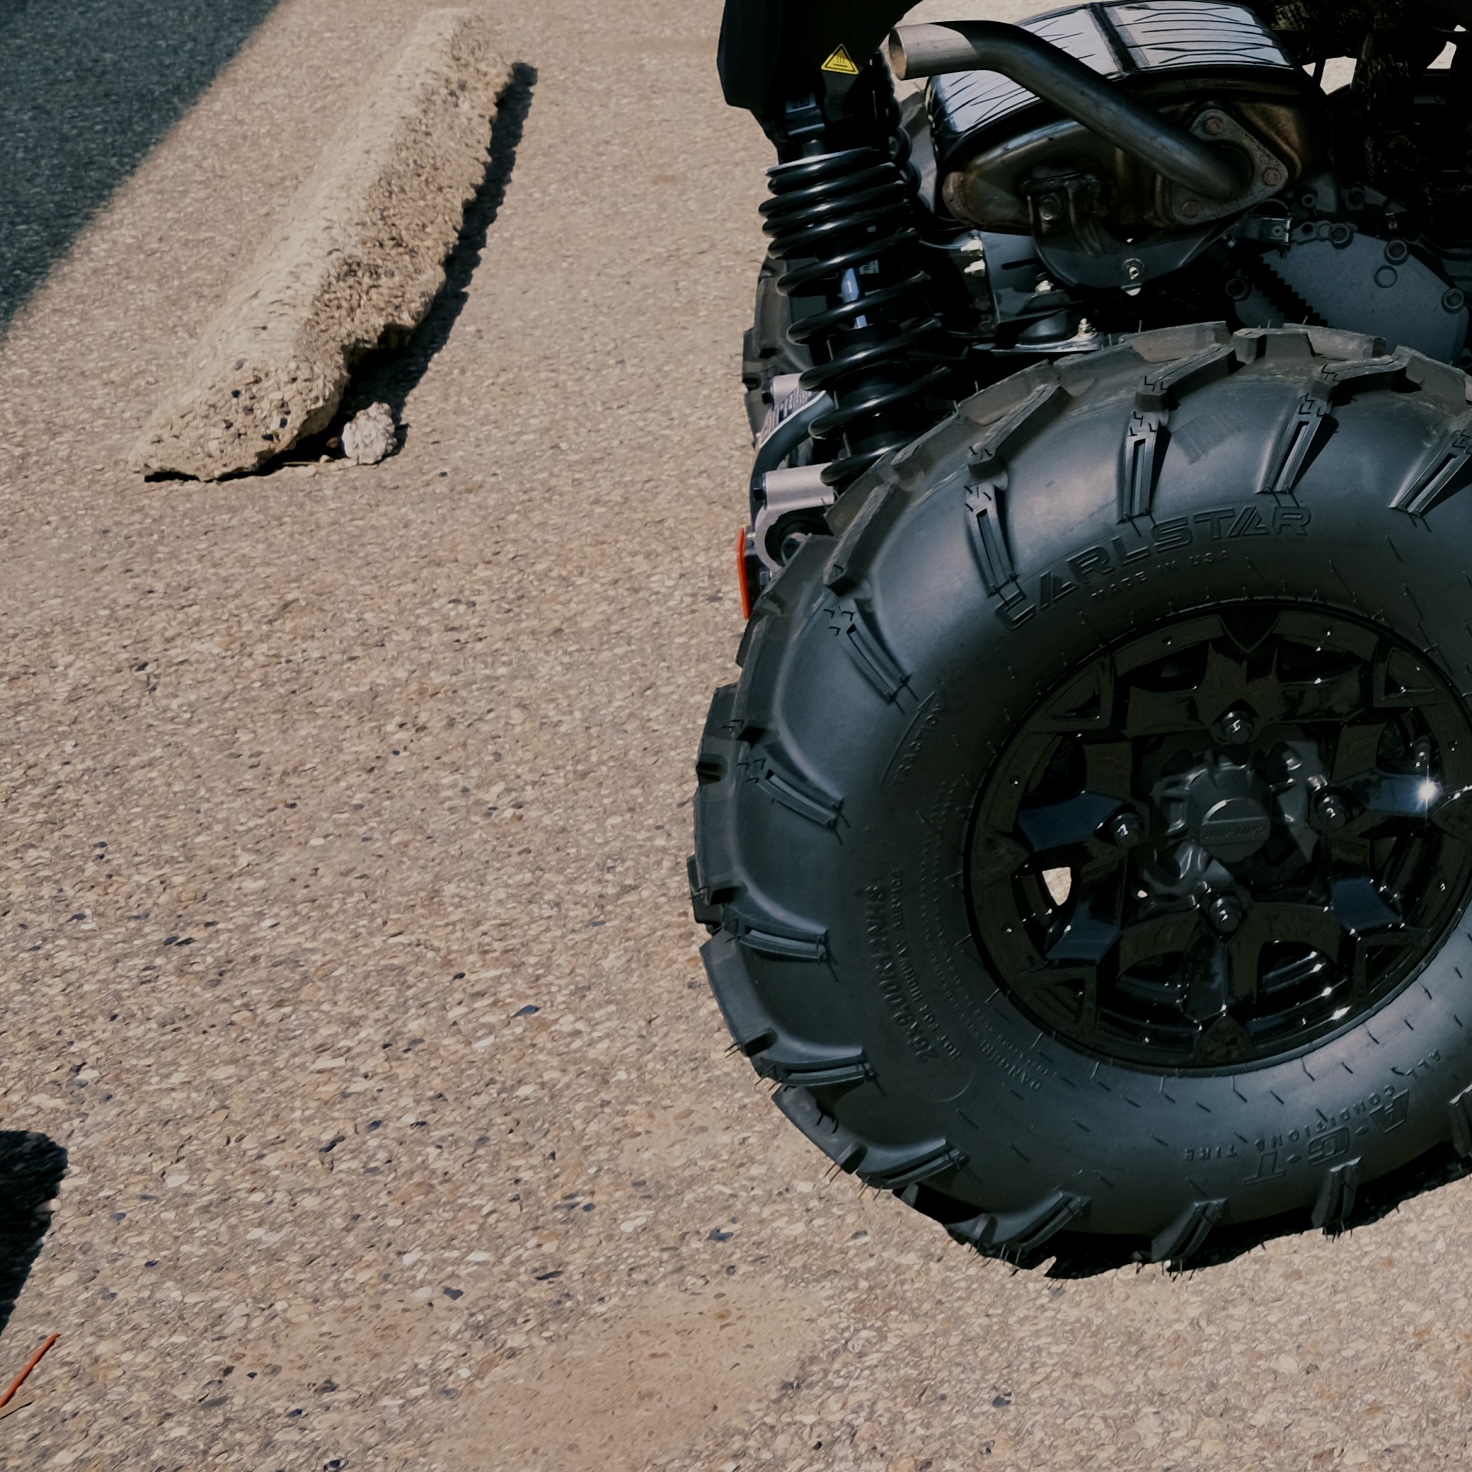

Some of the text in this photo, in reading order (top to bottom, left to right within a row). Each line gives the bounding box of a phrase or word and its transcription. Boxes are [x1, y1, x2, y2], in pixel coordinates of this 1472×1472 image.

[994, 505, 1312, 631] CARLSTAR
[1091, 549, 1230, 599] MADE IN USA
[1183, 1047, 1443, 1162] ALL CONDITIONS TIRE
